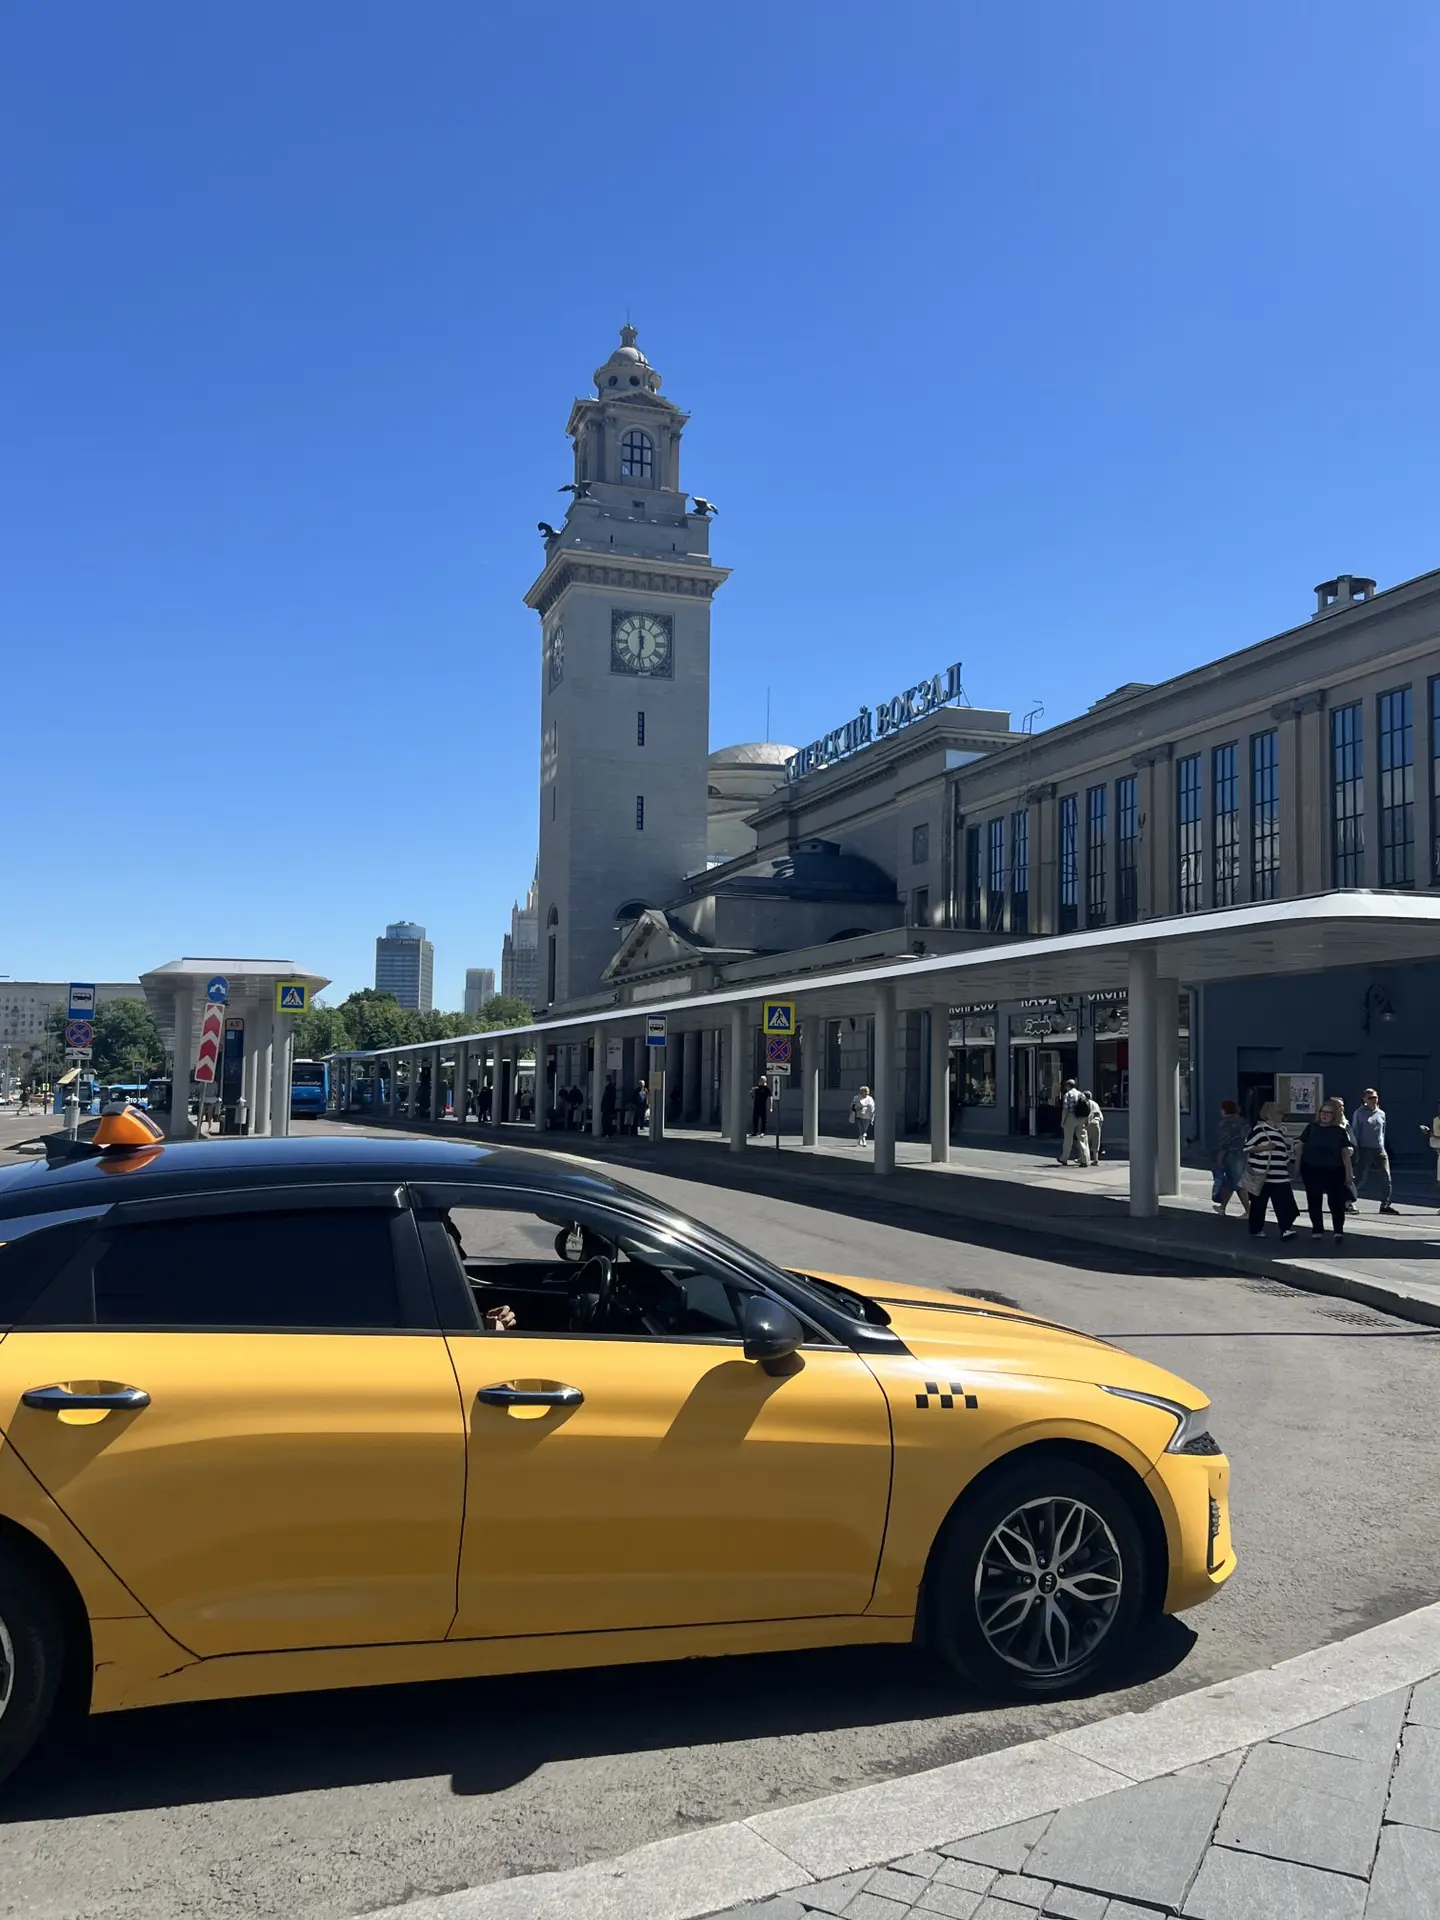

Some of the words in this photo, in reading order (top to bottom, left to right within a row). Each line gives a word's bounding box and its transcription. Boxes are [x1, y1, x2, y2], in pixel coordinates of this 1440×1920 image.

[784, 705, 872, 784] КИЕВСКИЙ
[876, 662, 962, 736] ВОКЗАЛ
[125, 1095, 137, 1104] Это
